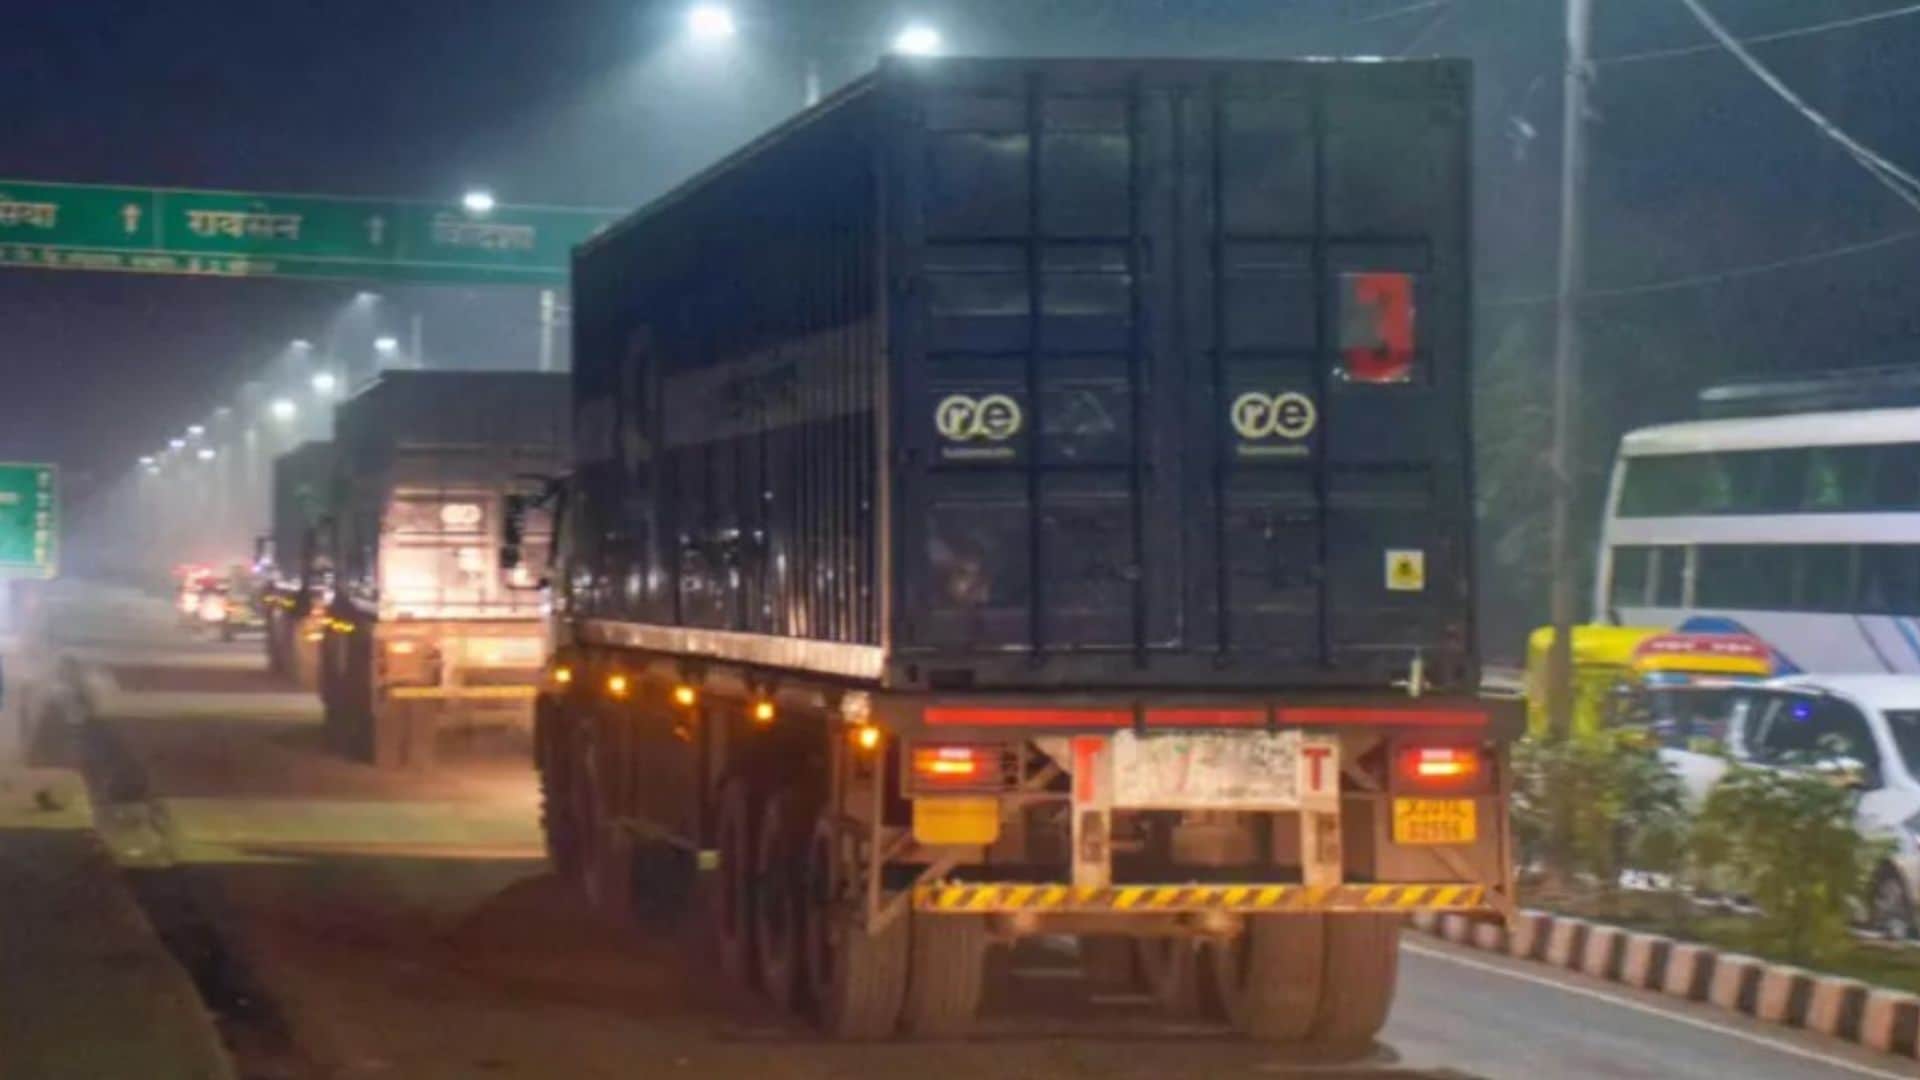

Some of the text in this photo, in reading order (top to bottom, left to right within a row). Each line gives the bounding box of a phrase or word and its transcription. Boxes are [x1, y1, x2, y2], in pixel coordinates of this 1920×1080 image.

[1344, 272, 1414, 381] 3
[937, 395, 1020, 439] re
[1231, 393, 1315, 437] re
[1070, 737, 1105, 803] T
[1302, 747, 1331, 791] T
